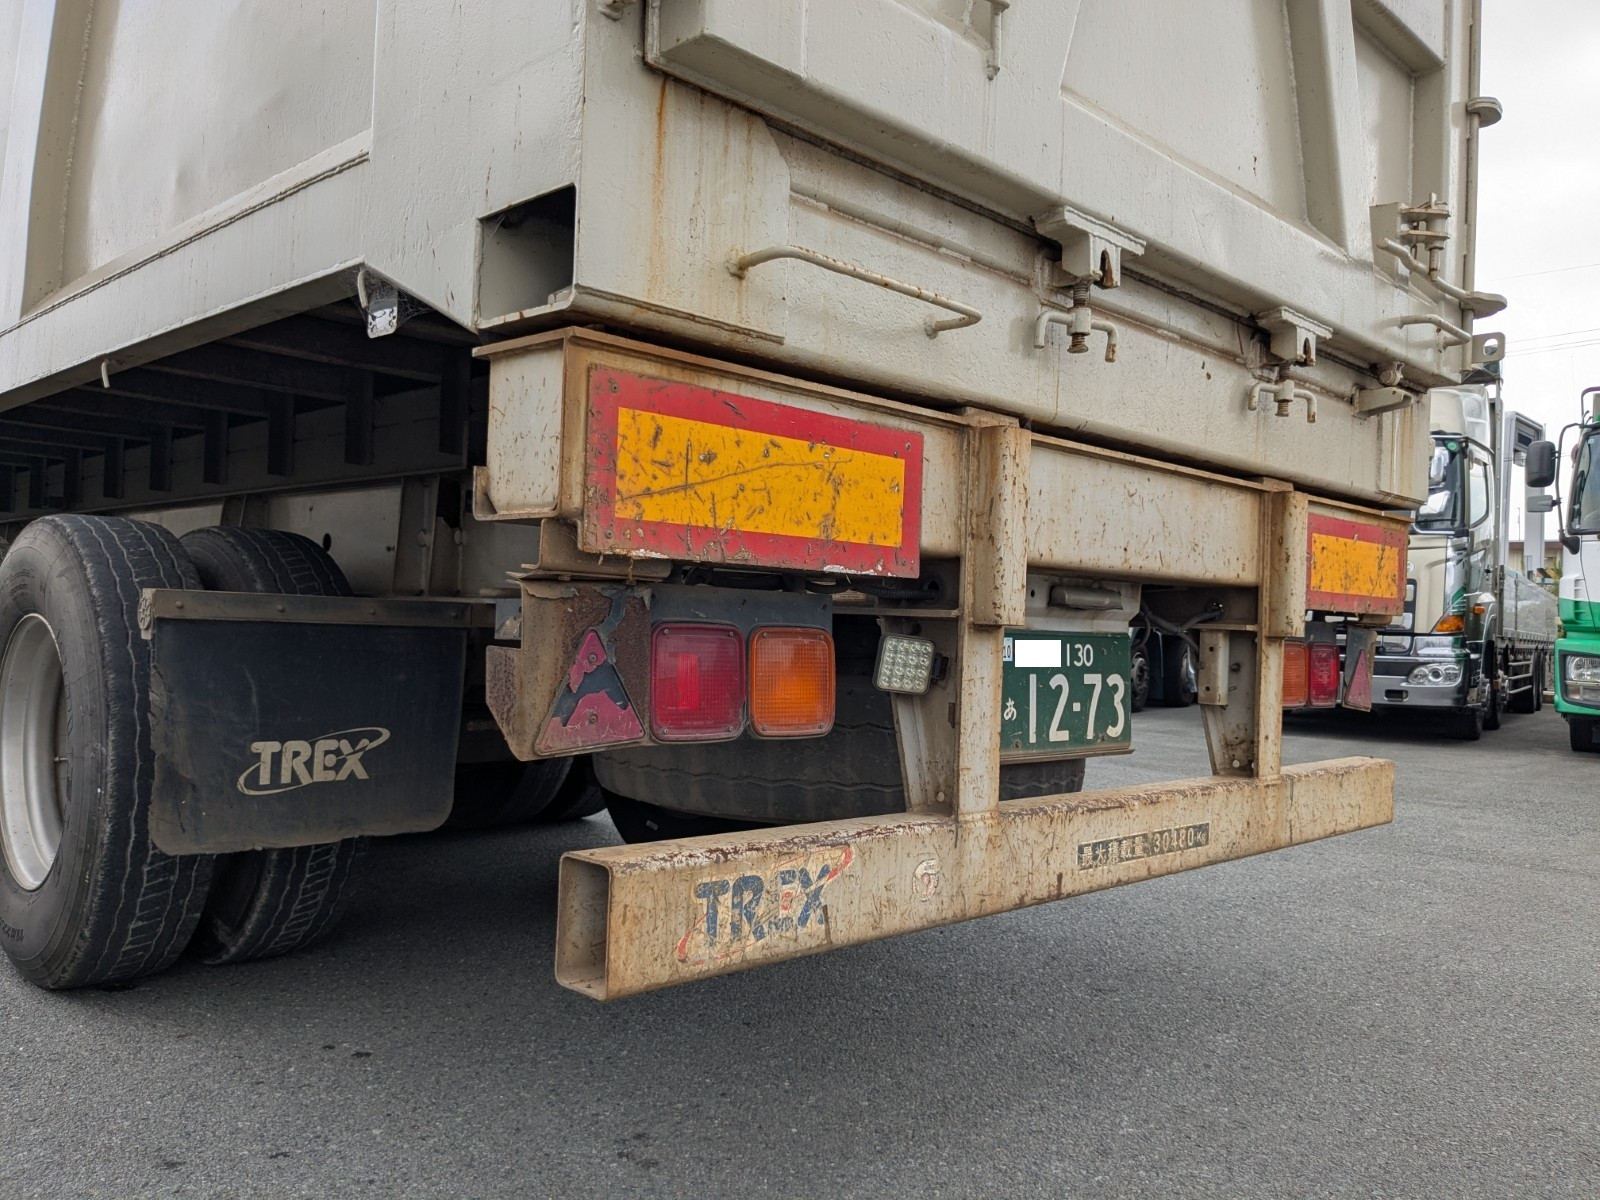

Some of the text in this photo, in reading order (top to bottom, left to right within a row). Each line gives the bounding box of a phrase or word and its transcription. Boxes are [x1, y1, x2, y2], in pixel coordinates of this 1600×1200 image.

[1066, 643, 1094, 667] 130
[1003, 673, 1125, 744] あ 12-73
[250, 738, 370, 787] TREX
